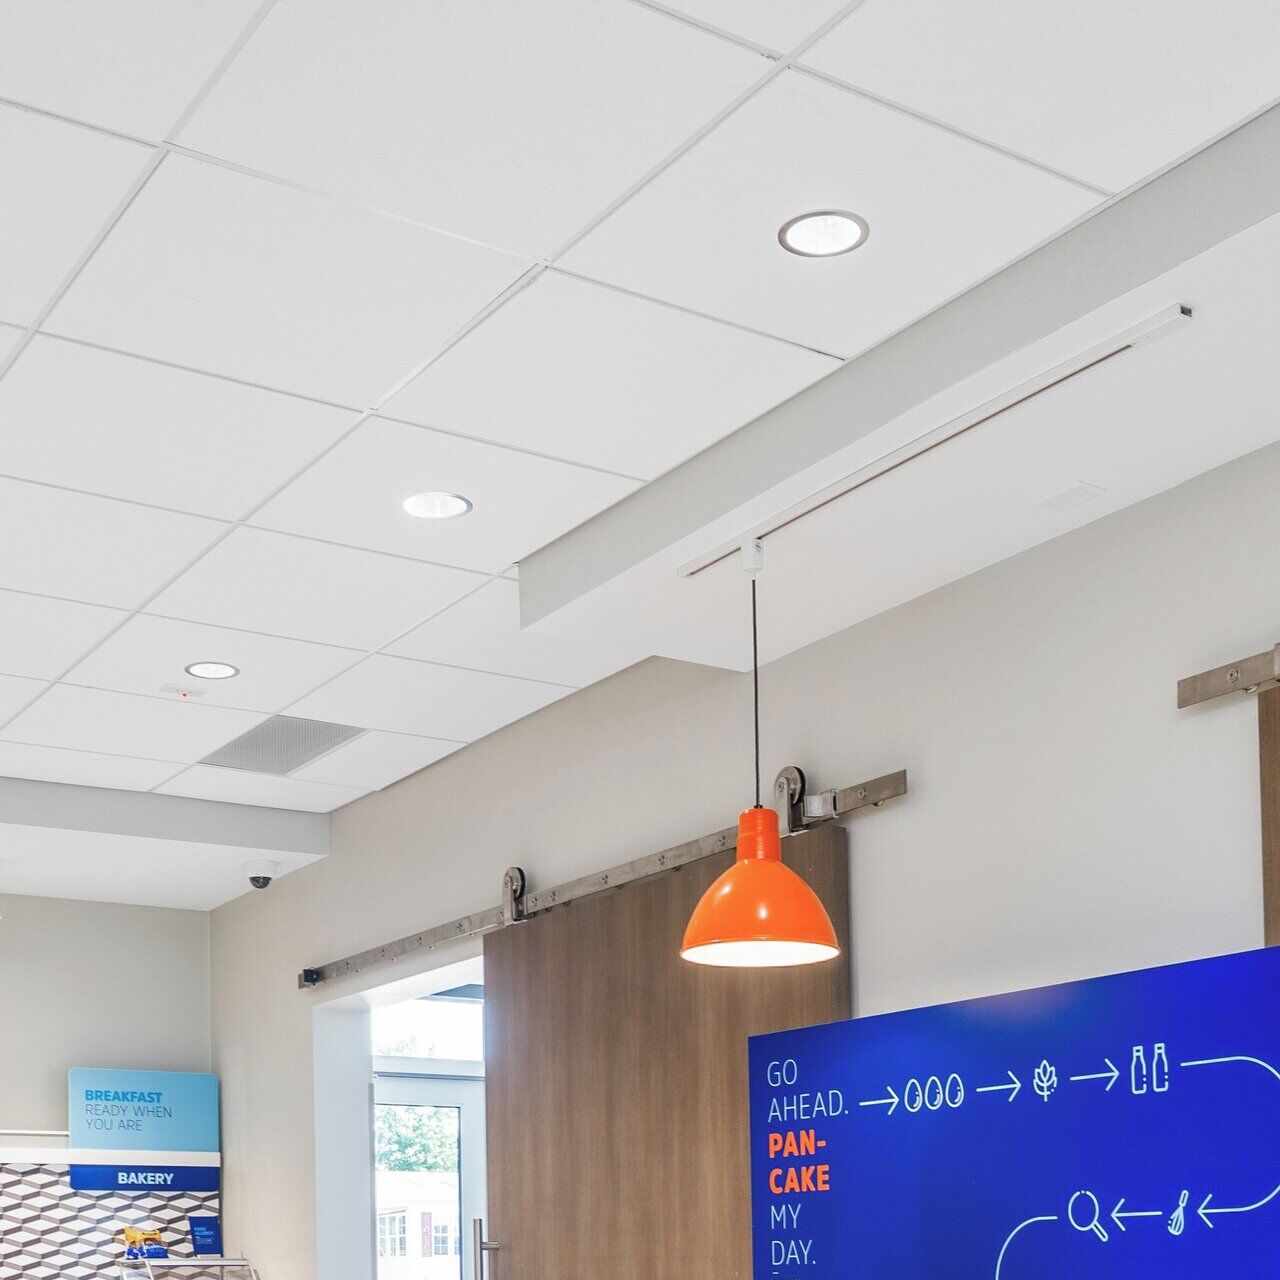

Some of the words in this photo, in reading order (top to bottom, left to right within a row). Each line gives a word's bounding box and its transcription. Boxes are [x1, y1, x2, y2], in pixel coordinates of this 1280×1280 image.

[767, 1059, 798, 1087] GO
[85, 1089, 163, 1104] BREAKFAST
[767, 1089, 849, 1123] AHEAD.
[85, 1104, 129, 1117] READY
[132, 1105, 173, 1118] WHEN
[85, 1119, 114, 1131] YOU
[117, 1119, 143, 1132] ARE
[768, 1129, 827, 1159] PAN-
[117, 1172, 174, 1185] BAKERY
[769, 1164, 830, 1194] CAKE
[770, 1203, 801, 1230] MY
[771, 1239, 817, 1266] DAY.
